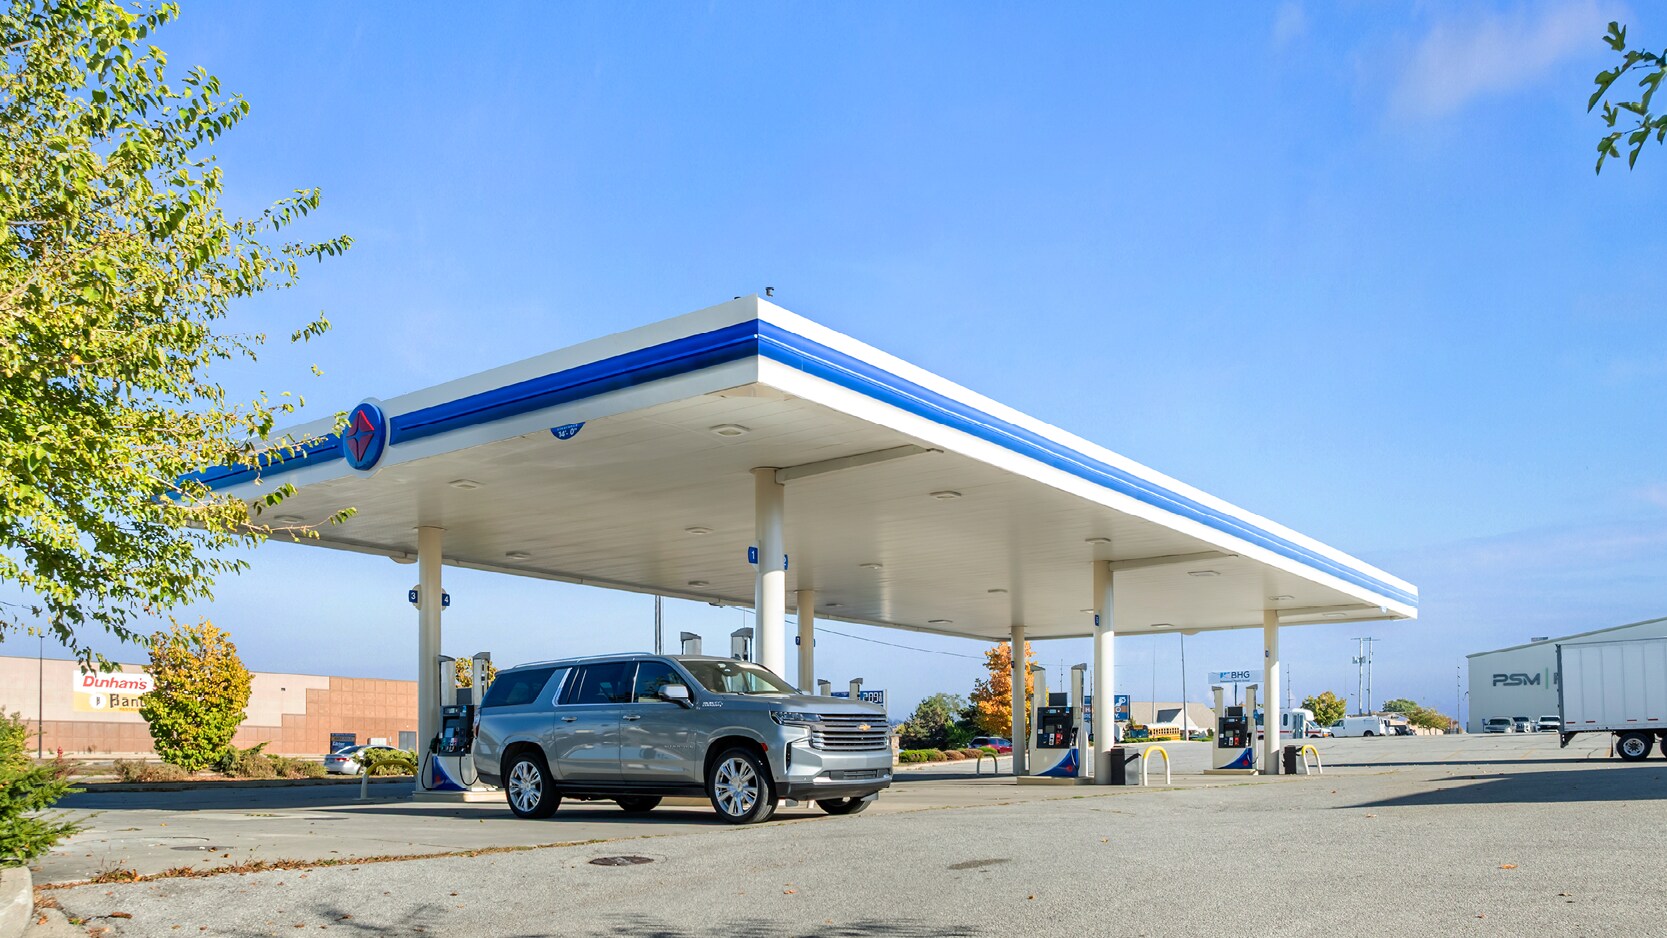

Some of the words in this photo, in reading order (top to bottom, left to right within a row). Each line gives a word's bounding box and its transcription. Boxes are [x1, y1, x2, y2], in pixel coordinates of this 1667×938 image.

[411, 591, 416, 600] 3
[444, 595, 449, 603] 4
[1231, 670, 1250, 679] BHG
[82, 675, 148, 691] Dunham's
[1493, 672, 1541, 687] PSM
